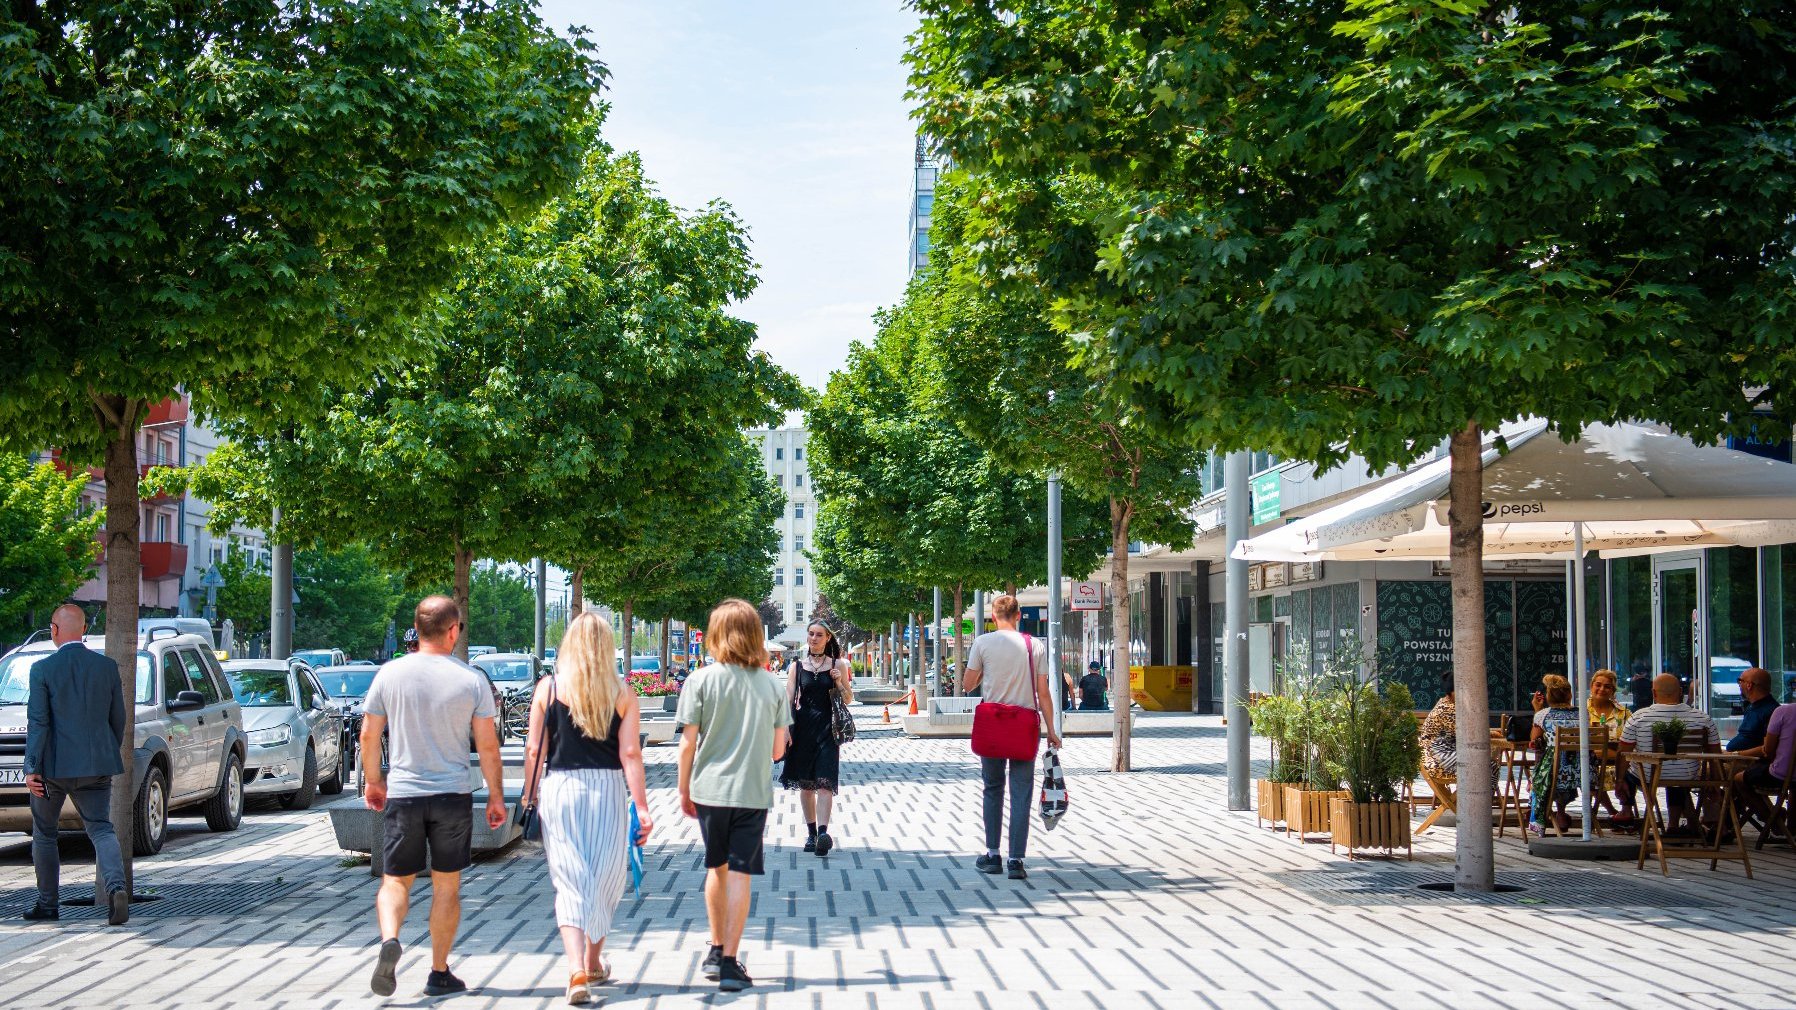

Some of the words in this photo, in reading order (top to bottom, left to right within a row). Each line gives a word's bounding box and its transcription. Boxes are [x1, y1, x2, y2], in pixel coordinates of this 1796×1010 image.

[1501, 502, 1545, 517] pepsi
[1437, 629, 1451, 637] TU
[1551, 630, 1567, 638] NI
[1403, 641, 1453, 649] POWSTAJ
[1551, 655, 1568, 663] ZB
